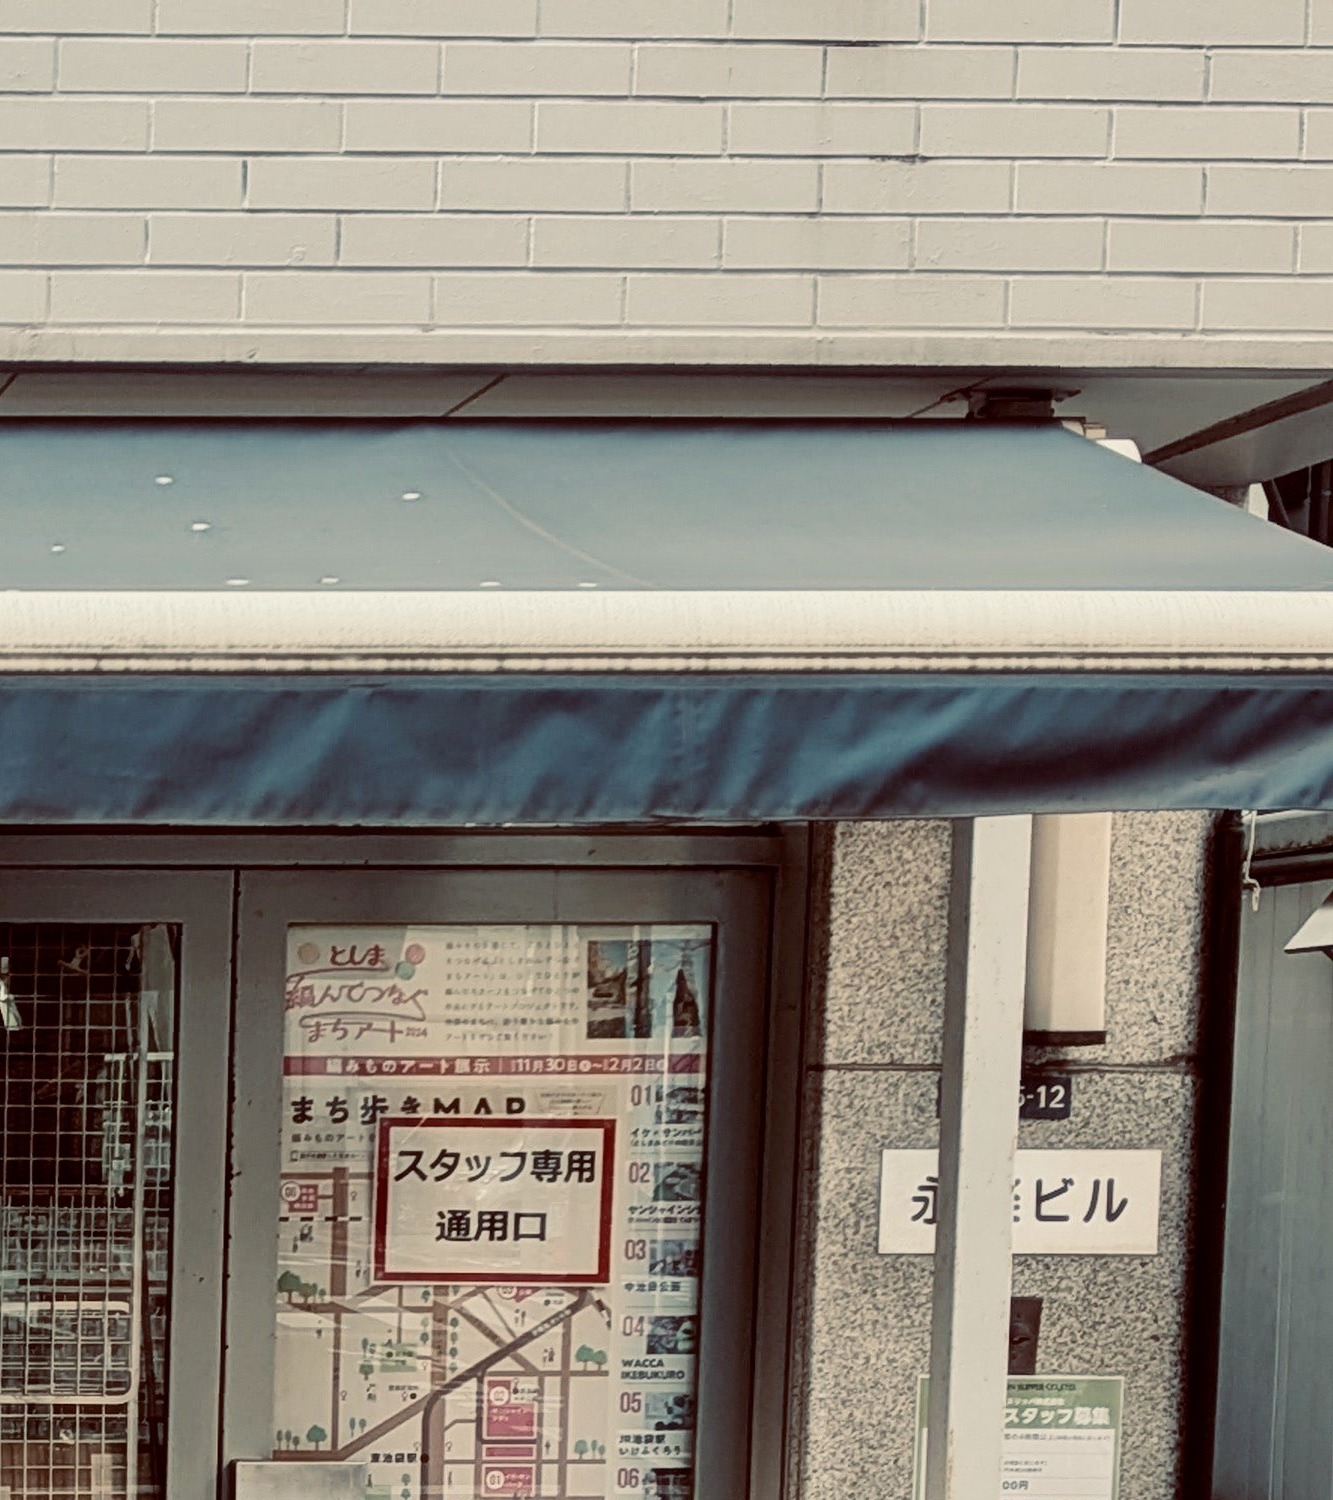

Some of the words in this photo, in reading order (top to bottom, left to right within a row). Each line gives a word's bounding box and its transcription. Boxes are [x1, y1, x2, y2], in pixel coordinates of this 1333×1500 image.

[330, 944, 387, 966] としま
[308, 1020, 403, 1043] まちアート
[631, 1084, 652, 1106] 01
[394, 1148, 596, 1184] スタッフ専用
[628, 1161, 650, 1184] 02
[435, 1209, 547, 1243] 通用口
[624, 1239, 646, 1260] 03
[622, 1315, 645, 1337] 04
[620, 1392, 642, 1413] 05
[617, 1468, 639, 1488] 06
